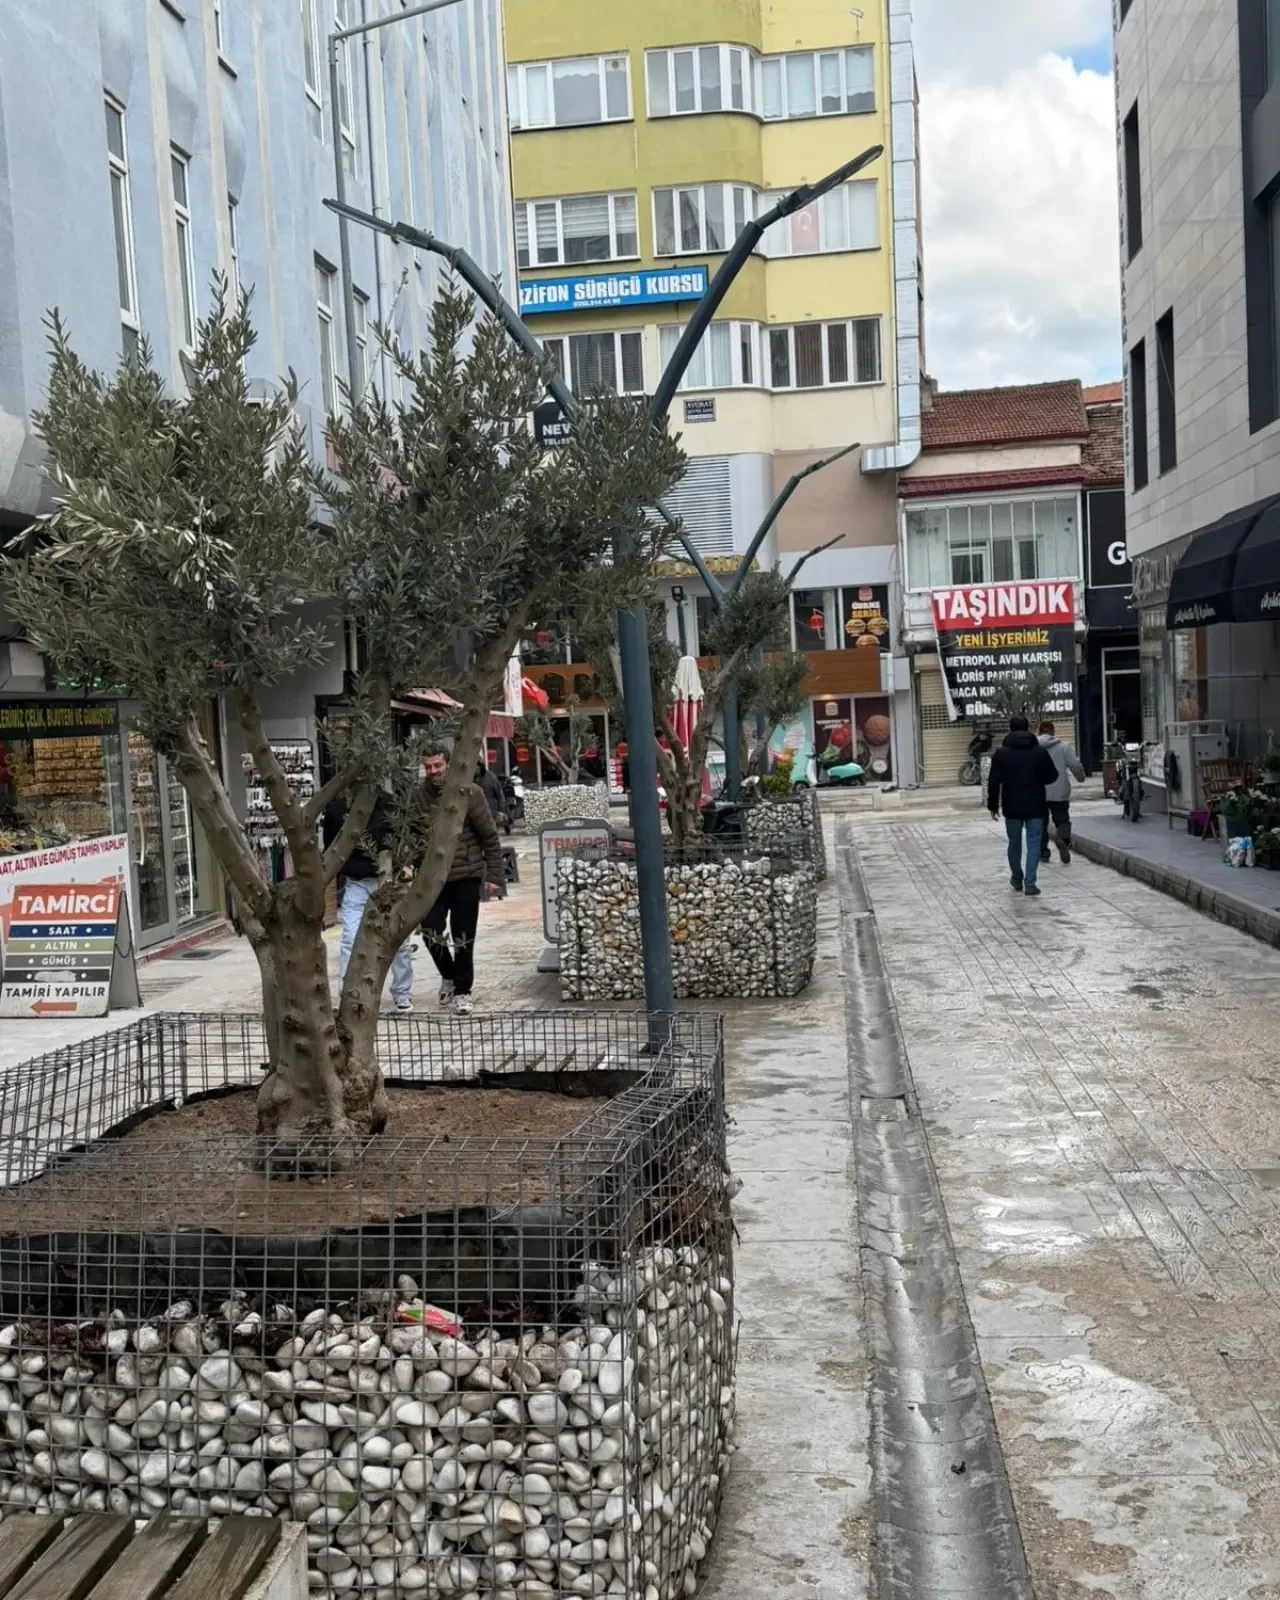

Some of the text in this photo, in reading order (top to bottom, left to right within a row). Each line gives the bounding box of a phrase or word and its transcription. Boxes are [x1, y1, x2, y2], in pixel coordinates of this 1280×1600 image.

[575, 276, 641, 301] SÜRÜCÜ
[646, 273, 703, 295] KURSU
[1107, 541, 1132, 566] G
[933, 583, 1069, 626] TAŞINDIK
[956, 628, 1049, 648] YENİ İŞYERİMİZ
[945, 651, 1062, 667] METROPOL AVM KARŞISI
[957, 669, 985, 683] LORİS
[15, 858, 37, 872] ALTIN
[37, 853, 49, 866] VE
[48, 847, 77, 864] GÜMÜŞ
[78, 840, 100, 857] TAMİRİ
[18, 888, 115, 914] TAMİRCİ
[48, 926, 77, 935] SAAT
[44, 941, 78, 950] ALTIN
[41, 955, 77, 966] GÜMÜŞ
[5, 984, 106, 998] TAMİRİ YAPILIR
